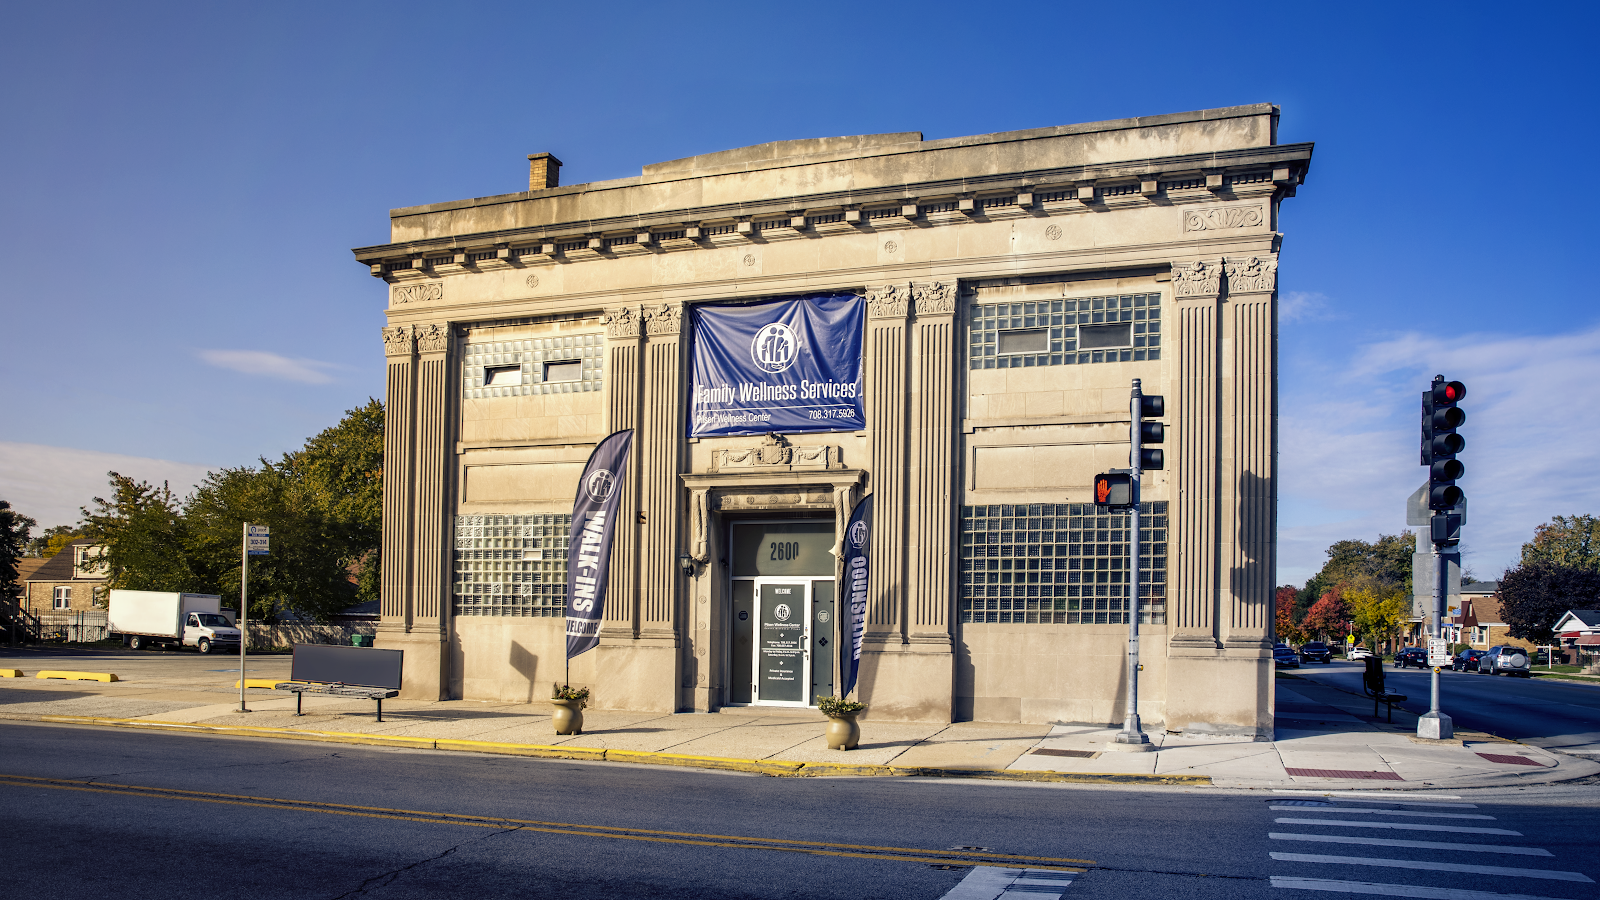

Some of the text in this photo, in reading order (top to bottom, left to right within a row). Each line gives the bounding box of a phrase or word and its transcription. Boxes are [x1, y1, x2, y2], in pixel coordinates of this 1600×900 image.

[697, 378, 855, 405] Family Wellness Services
[697, 412, 772, 424] Pilsen Wellness Center
[808, 408, 855, 419] 708.317.5926
[573, 510, 606, 613] WALK-INS
[770, 541, 799, 561] 2600
[851, 556, 867, 661] COUNSELING
